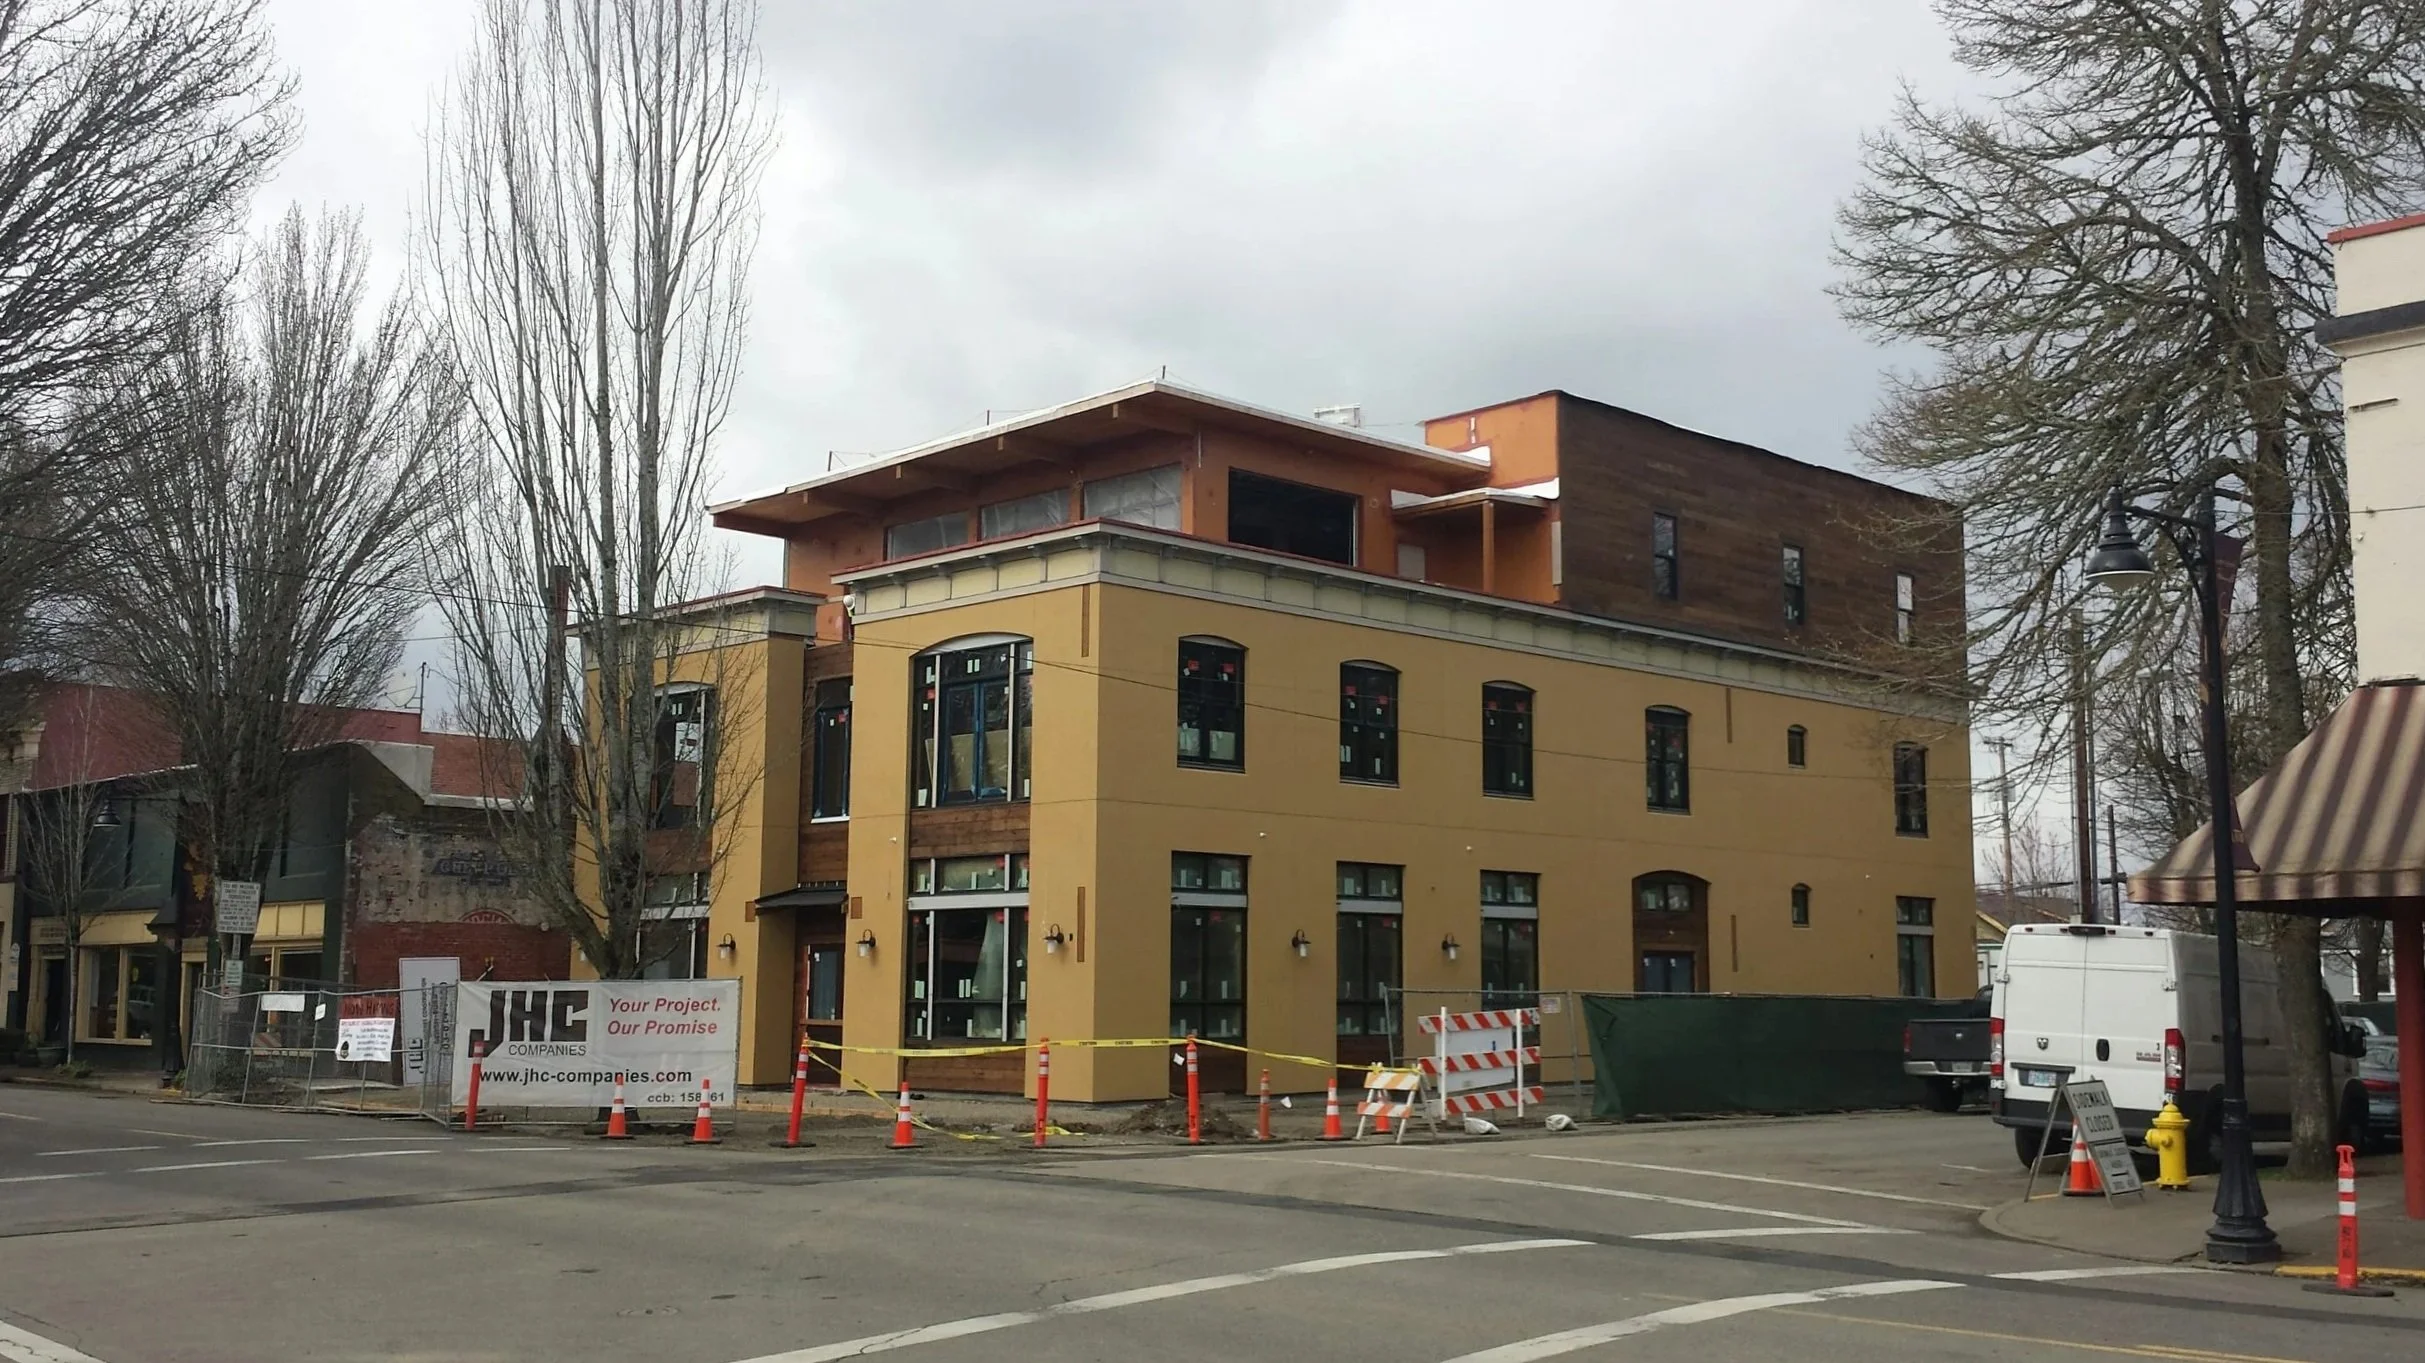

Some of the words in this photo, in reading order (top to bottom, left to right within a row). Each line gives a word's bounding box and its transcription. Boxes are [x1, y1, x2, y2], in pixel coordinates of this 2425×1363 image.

[609, 998, 650, 1013] Your
[654, 997, 721, 1015] Project.
[468, 990, 589, 1058] JHC
[607, 1020, 639, 1035] Our
[644, 1019, 718, 1035] Promise
[508, 1044, 587, 1056] COMPANIES
[479, 1068, 692, 1086] www.jhc-companies.com
[647, 1093, 675, 1103] ccb:
[680, 1092, 725, 1103] 15861
[2072, 1091, 2109, 1110] SIDEWALK
[2085, 1114, 2114, 1133] CLOSED
